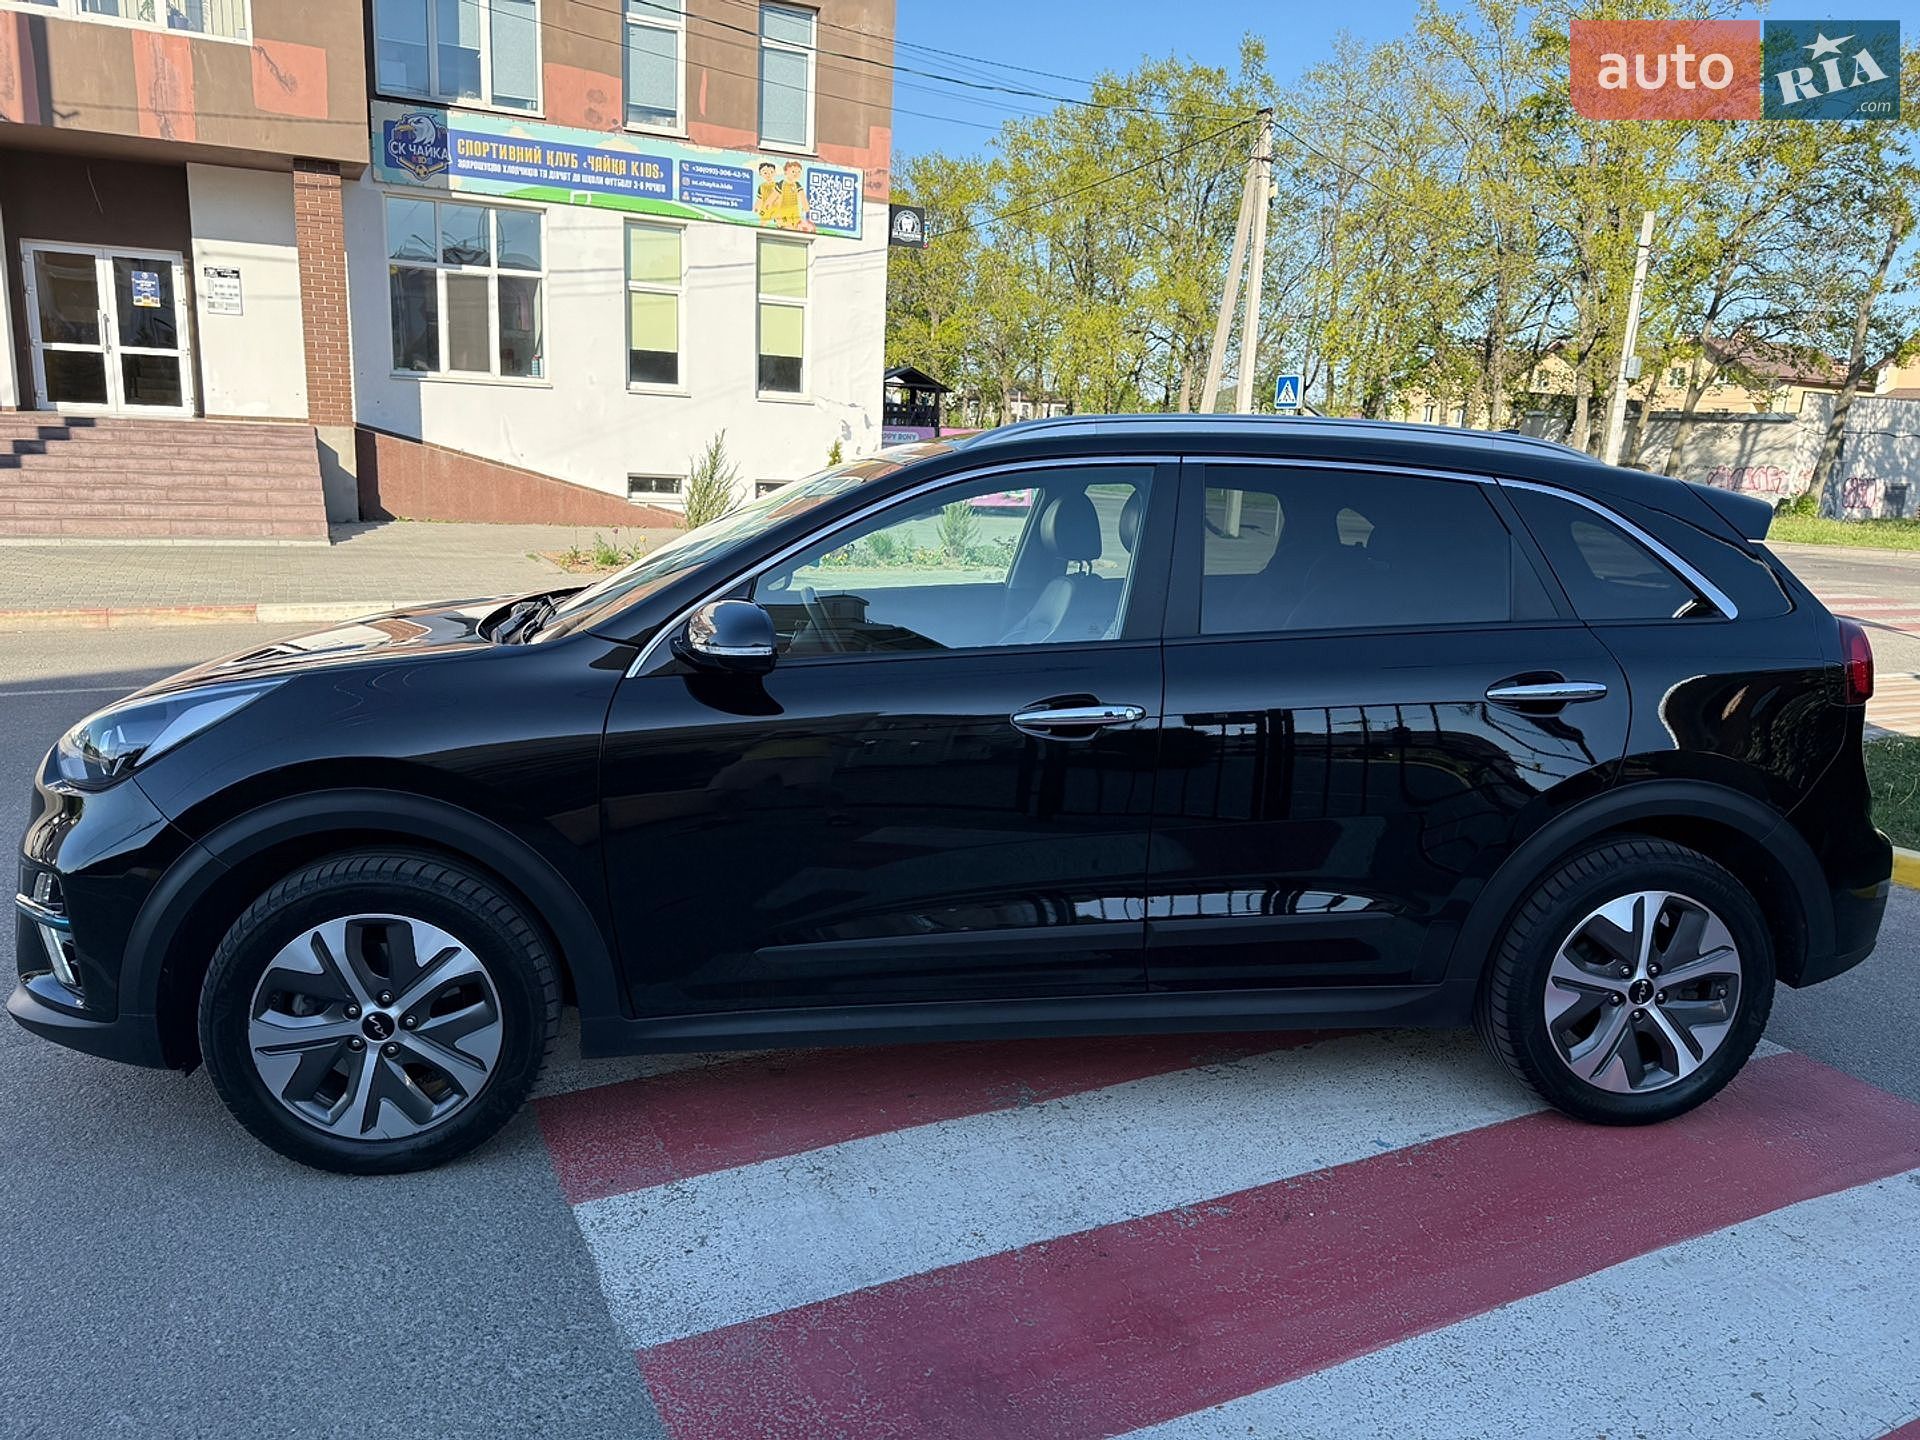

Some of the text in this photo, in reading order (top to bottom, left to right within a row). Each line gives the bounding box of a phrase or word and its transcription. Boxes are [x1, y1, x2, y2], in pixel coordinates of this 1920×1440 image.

[390, 141, 449, 160] СК ЧАЙКА
[457, 138, 542, 165] СПОРТИВНИЙ
[546, 149, 579, 169] КЛУБ
